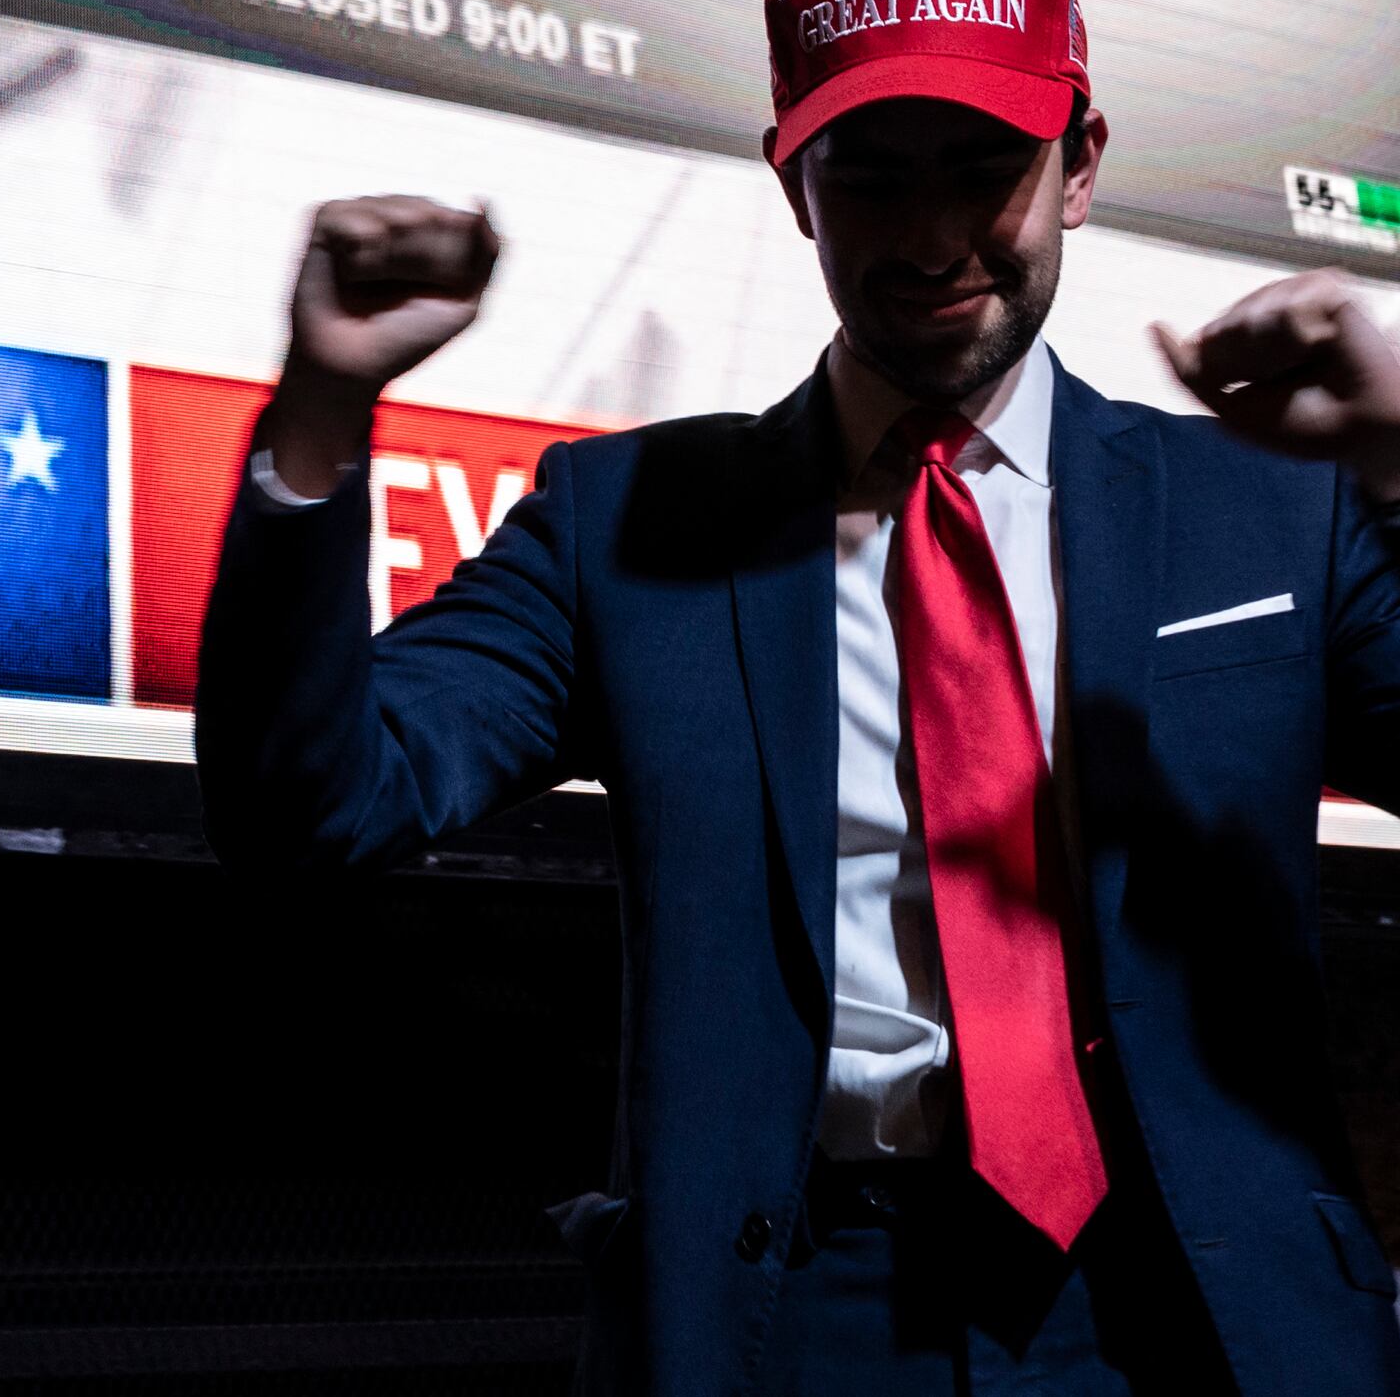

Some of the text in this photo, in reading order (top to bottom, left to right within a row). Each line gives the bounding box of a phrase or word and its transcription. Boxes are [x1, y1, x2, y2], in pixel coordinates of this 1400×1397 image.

[463, 0, 565, 63] 9:00
[583, 21, 642, 78] ET
[369, 456, 527, 637] EY
